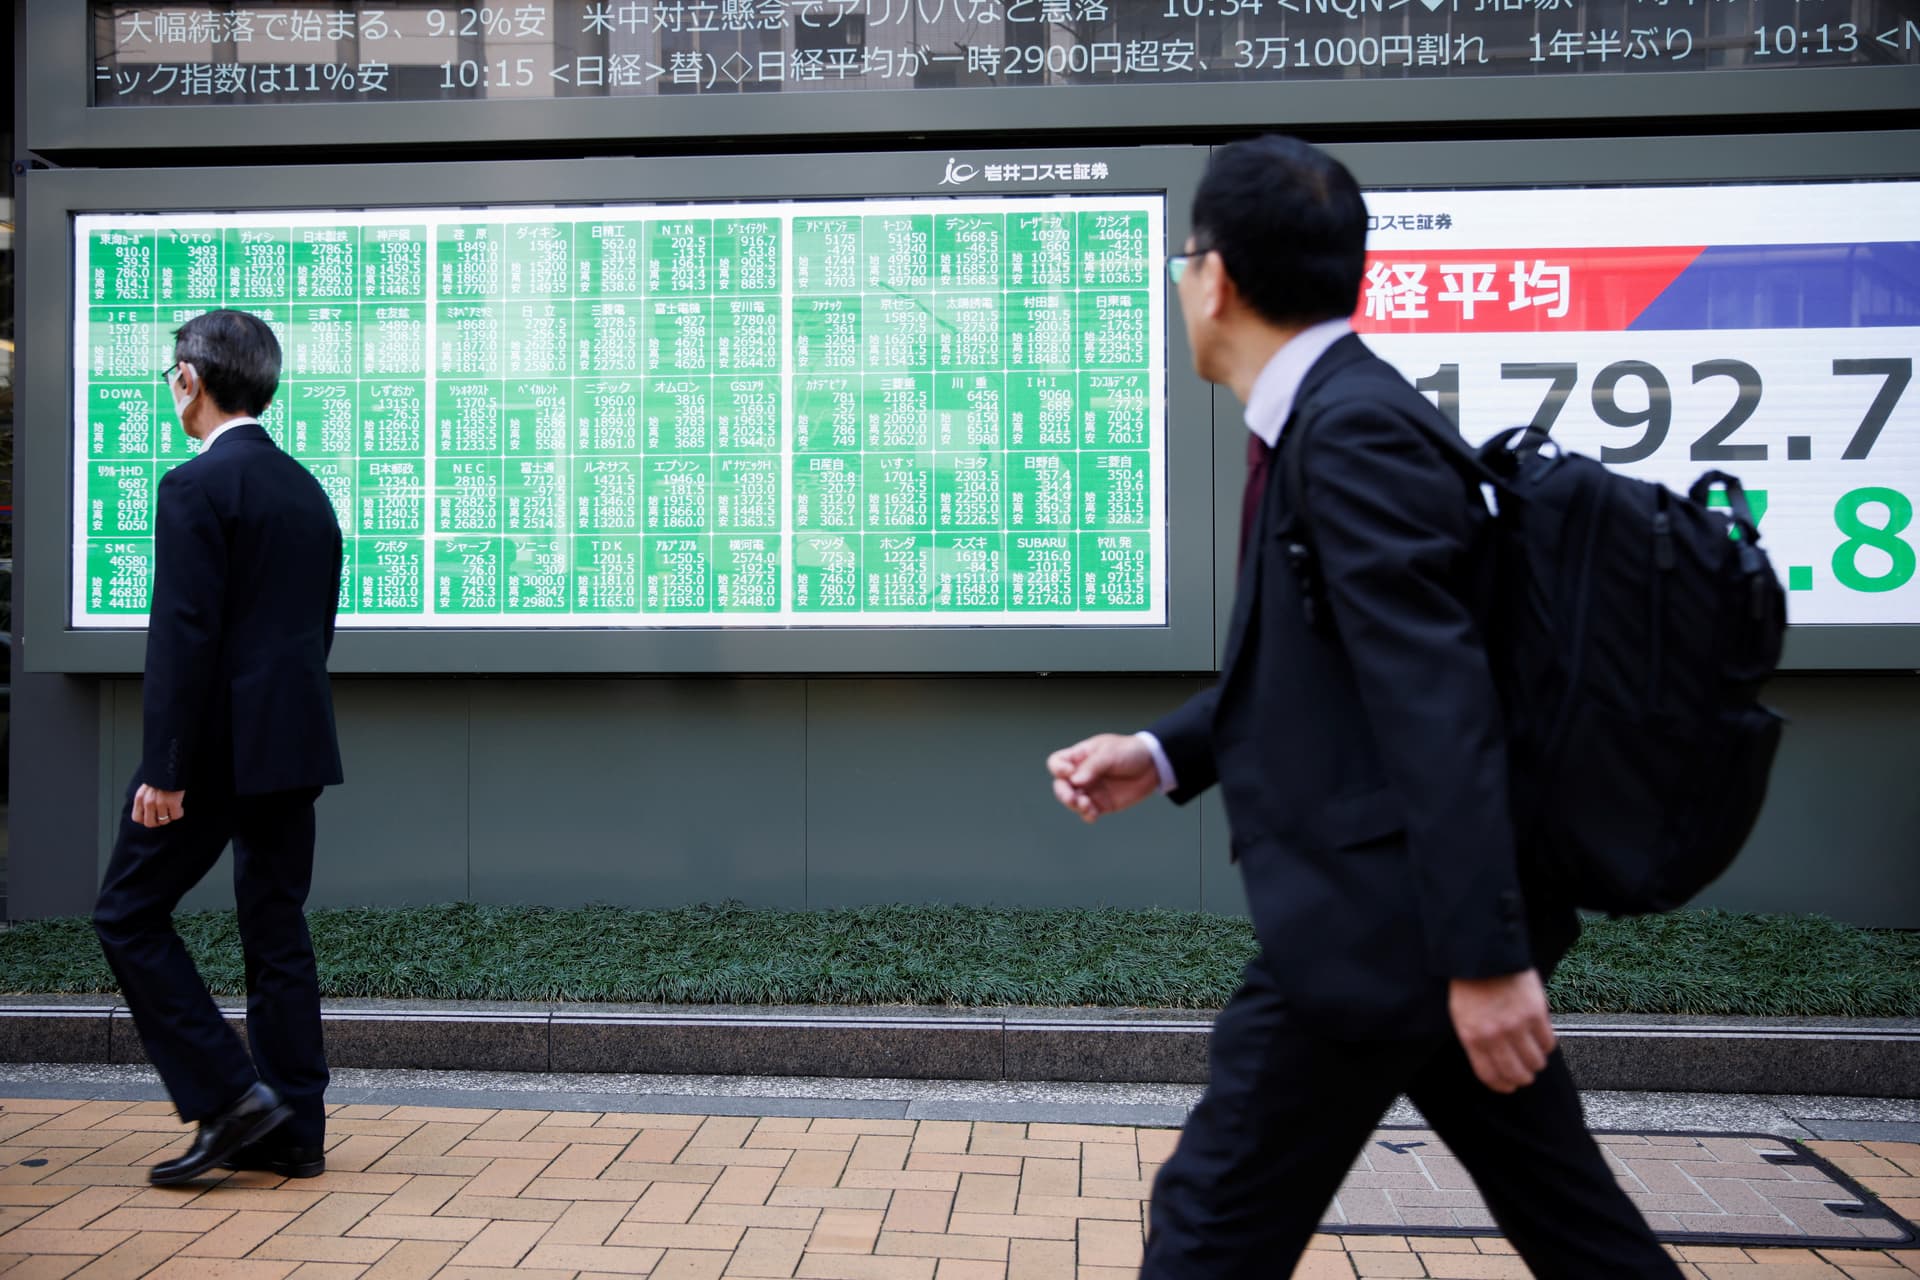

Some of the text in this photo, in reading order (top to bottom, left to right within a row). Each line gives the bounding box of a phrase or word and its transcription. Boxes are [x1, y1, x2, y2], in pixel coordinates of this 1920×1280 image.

[440, 58, 535, 89] 10:15
[1529, 28, 1693, 63] 1年半ぶり
[1754, 23, 1859, 55] 10:13
[984, 162, 1109, 182] 岩井コスモ証券
[946, 219, 992, 231] デンソー
[1095, 216, 1131, 228] カシオ
[662, 224, 693, 236] NTN
[1099, 230, 1142, 241] 1064.0
[169, 232, 211, 244] TOTO
[670, 238, 705, 248] 202.5
[955, 233, 997, 244] 1668.5
[116, 247, 150, 257] 810.0
[187, 246, 217, 256] 3493
[965, 243, 998, 254] -46.5
[1109, 241, 1142, 252] -42.0
[672, 248, 705, 259] -13.5
[1099, 252, 1142, 263] 1054.5
[118, 257, 150, 267] -59.5
[189, 256, 217, 266] -203
[670, 259, 705, 269] 196.1
[955, 254, 998, 265] 1595.0
[116, 268, 150, 278] 786.0
[187, 267, 217, 277] 3450
[955, 265, 998, 276] 1685.0
[1099, 262, 1142, 273] 1071.0
[670, 269, 705, 280] 203.4
[1099, 273, 1142, 284] 1036.5
[116, 278, 150, 288] 814.1
[187, 277, 217, 287] 3500
[670, 280, 705, 291] 194.3
[955, 275, 998, 286] 1568.5
[116, 288, 150, 299] 765.1
[187, 287, 216, 298] 3391
[732, 315, 774, 326] 2780.0
[1099, 310, 1142, 321] 2344.0
[735, 326, 774, 336] -564.0
[1102, 321, 1142, 331] -176.5
[732, 336, 774, 347] 2694.0
[1099, 332, 1143, 343] 2346.0
[732, 347, 774, 358] 2824.0
[1099, 342, 1143, 353] 2394.5
[733, 357, 774, 368] 2644.0
[1099, 353, 1143, 364] 2290.5
[656, 381, 698, 393] オムロン
[1027, 377, 1055, 389] IHI
[99, 387, 142, 399] DOWA
[303, 385, 346, 396] フジクラ
[371, 384, 414, 396] しずおか
[674, 395, 705, 405] 3816
[1039, 391, 1071, 402] 9060
[119, 401, 149, 411] 4072
[321, 399, 351, 409] 3766
[377, 398, 418, 409] 1315.0
[1042, 402, 1071, 412] -685
[121, 411, 149, 421] -266
[323, 409, 351, 419] -526
[387, 408, 418, 419] -76.5
[677, 405, 705, 416] -304
[674, 416, 705, 427] 3783
[1039, 412, 1071, 423] 8695
[119, 422, 149, 432] 4000
[321, 420, 351, 430] 3592
[377, 419, 418, 430] 1266.0
[1039, 423, 1071, 434] 9211
[119, 432, 149, 442] 4087
[321, 430, 351, 440] 3793
[377, 429, 418, 440] 1321.5
[674, 427, 705, 437] 3828
[377, 440, 418, 450] 1252.0
[674, 437, 705, 448] 3685
[1039, 434, 1071, 445] 8455
[119, 442, 149, 453] 3940
[320, 440, 351, 451] 3592
[452, 462, 484, 473] NEC
[585, 460, 627, 472] ルネサス
[955, 457, 990, 469] トヨタ
[456, 475, 496, 486] 2810.5
[593, 474, 635, 485] 1421.5
[955, 471, 999, 482] 2303.5
[1108, 470, 1143, 481] 350.4
[119, 478, 148, 488] 6687
[958, 482, 999, 492] -104.0
[1110, 481, 1143, 491] -19.6
[121, 489, 148, 498] -743
[458, 486, 496, 496] -170.0
[595, 485, 635, 495] -234.5
[455, 496, 496, 507] 2682.5
[593, 495, 635, 506] 1346.0
[956, 493, 999, 504] 2250.0
[1108, 492, 1144, 502] 333.1
[118, 499, 148, 509] 6180
[956, 504, 999, 514] 2355.0
[1108, 503, 1144, 513] 351.5
[118, 509, 148, 520] 6717
[455, 507, 496, 517] 2829.0
[593, 506, 635, 516] 1480.5
[455, 517, 496, 528] 2682.0
[593, 516, 635, 527] 1320.0
[956, 514, 999, 525] 2226.5
[1108, 513, 1144, 524] 328.2
[118, 520, 148, 530] 6050
[105, 542, 135, 553] SMC
[375, 540, 408, 552] クボタ
[445, 540, 490, 551] シャープ
[592, 539, 622, 551] TDK
[1017, 537, 1067, 548] SUBARU
[111, 556, 148, 566] 46580
[377, 554, 418, 565] 1521.5
[463, 554, 496, 564] 726.3
[593, 553, 635, 564] 1201.5
[1028, 551, 1072, 562] 2316.0
[113, 566, 148, 576] -2750
[386, 565, 418, 575] -95.0
[465, 564, 496, 574] -76.0
[595, 564, 635, 574] -129.5
[1030, 562, 1072, 572] -101.5
[111, 576, 148, 587] 44410
[377, 575, 418, 586] 1507.0
[463, 575, 496, 585] 740.0
[593, 574, 635, 585] 1181.0
[1028, 572, 1072, 583] 2218.5
[111, 587, 148, 597] 46830
[376, 586, 418, 596] 1531.0
[462, 585, 496, 596] 745.3
[593, 585, 635, 595] 1222.0
[1028, 583, 1072, 594] 2343.5
[111, 597, 148, 607] 44110
[376, 596, 418, 607] 1460.5
[462, 596, 496, 606] 720.0
[593, 595, 635, 606] 1165.0
[1028, 594, 1072, 605] 2174.0
